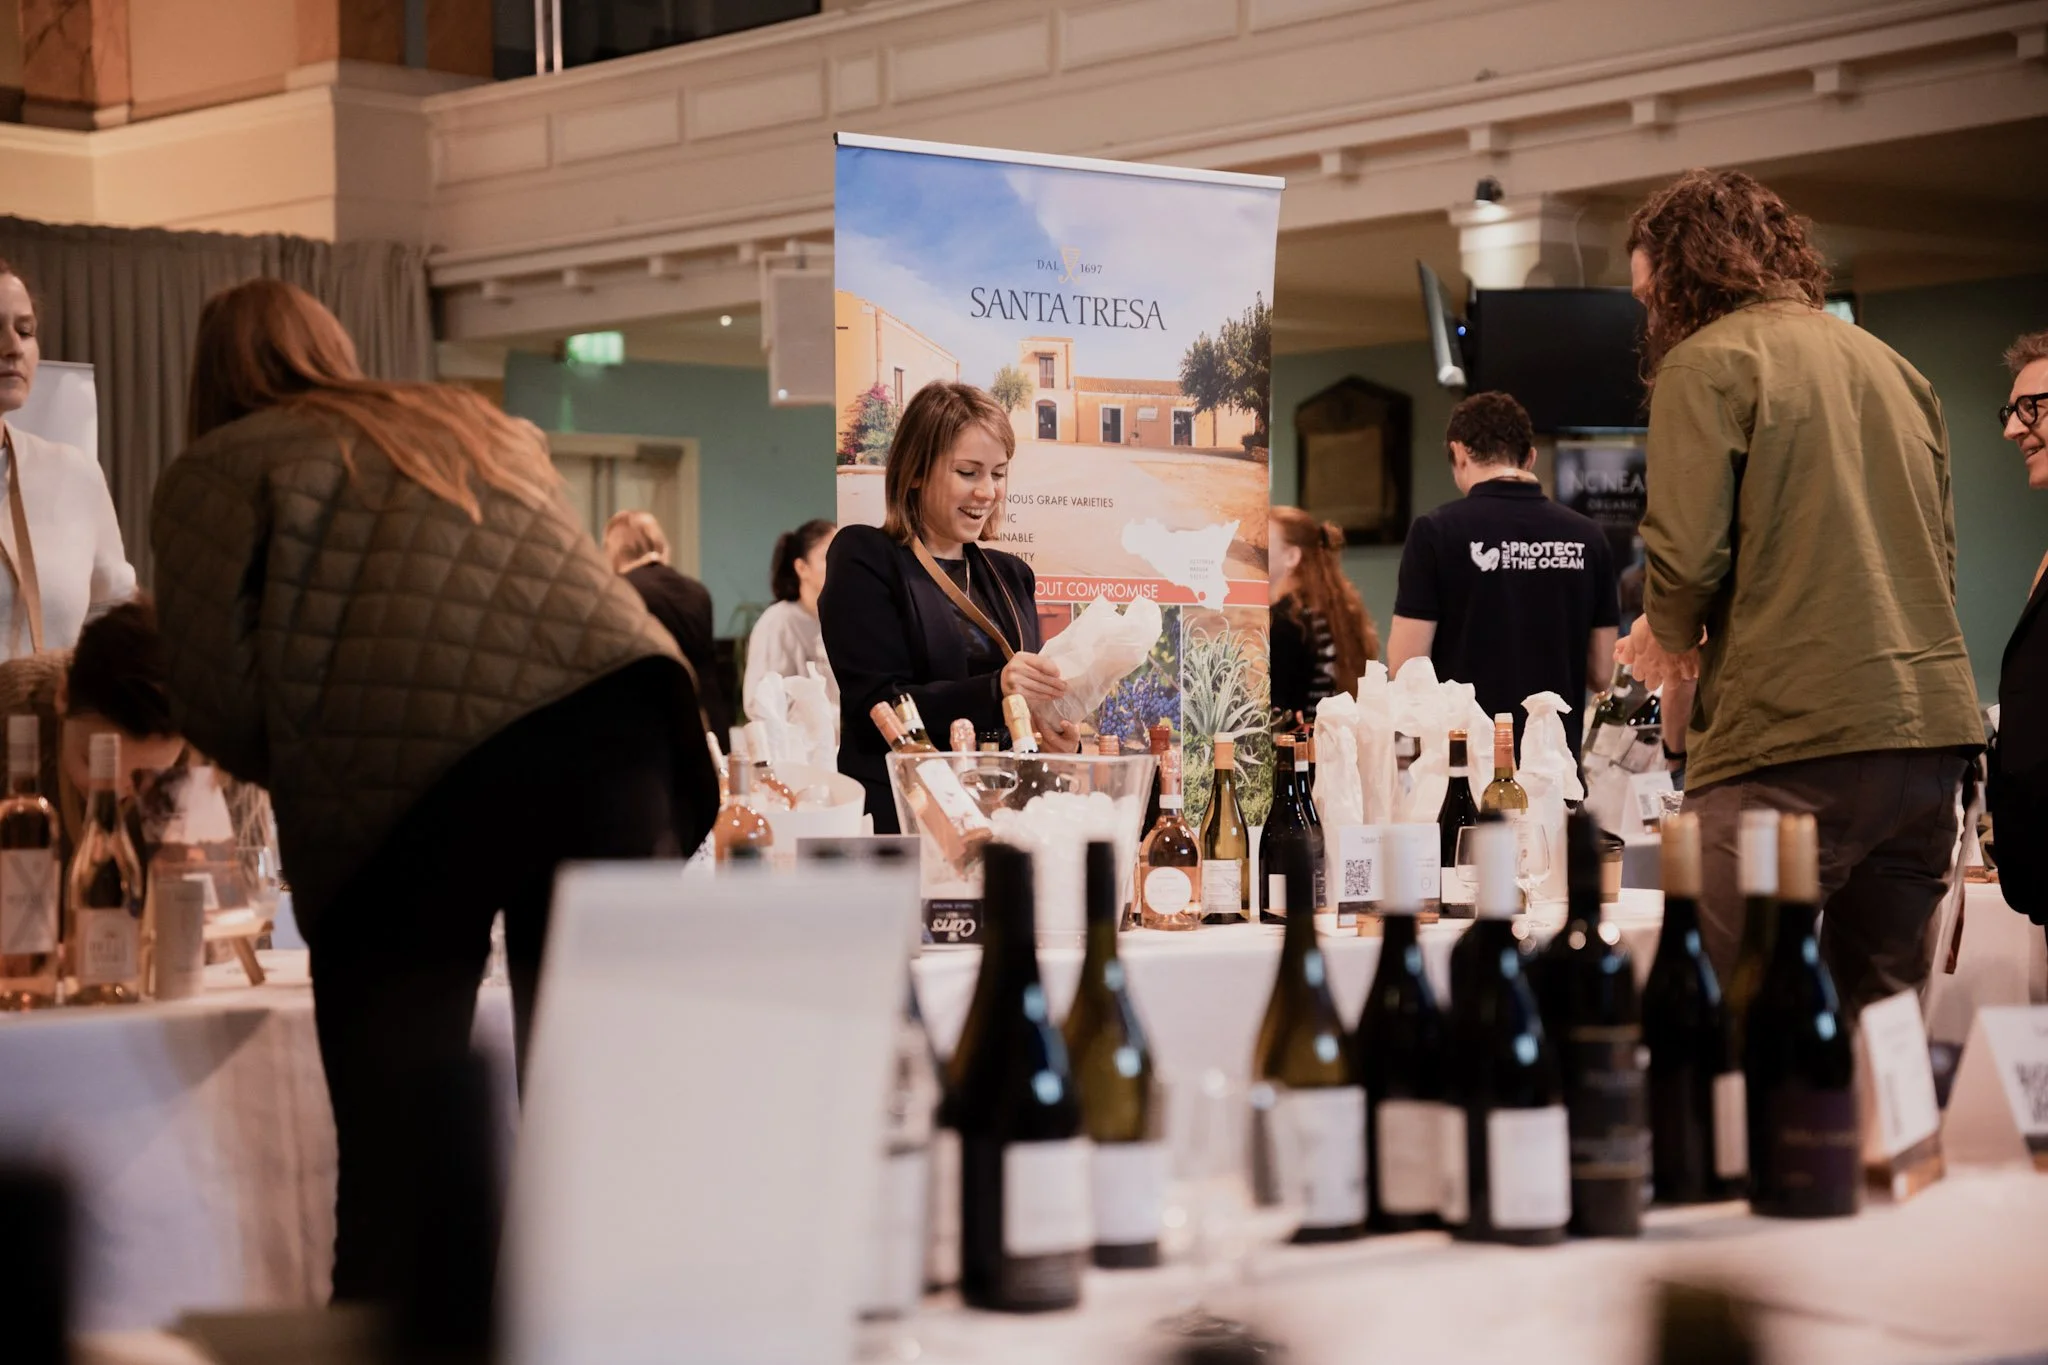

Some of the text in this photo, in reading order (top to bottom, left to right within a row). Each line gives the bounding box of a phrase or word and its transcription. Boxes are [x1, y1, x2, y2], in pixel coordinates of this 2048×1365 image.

[1037, 259, 1103, 274] DAL 1697
[970, 287, 1167, 331] SANTA TRESA
[1037, 495, 1068, 506] GRAPE
[1071, 497, 1114, 508] VARIETIES
[1501, 541, 1511, 569] HELP
[1510, 541, 1585, 557] PROTECT
[1511, 557, 1585, 570] THE OCEAN
[1066, 581, 1159, 599] COMPROMISE
